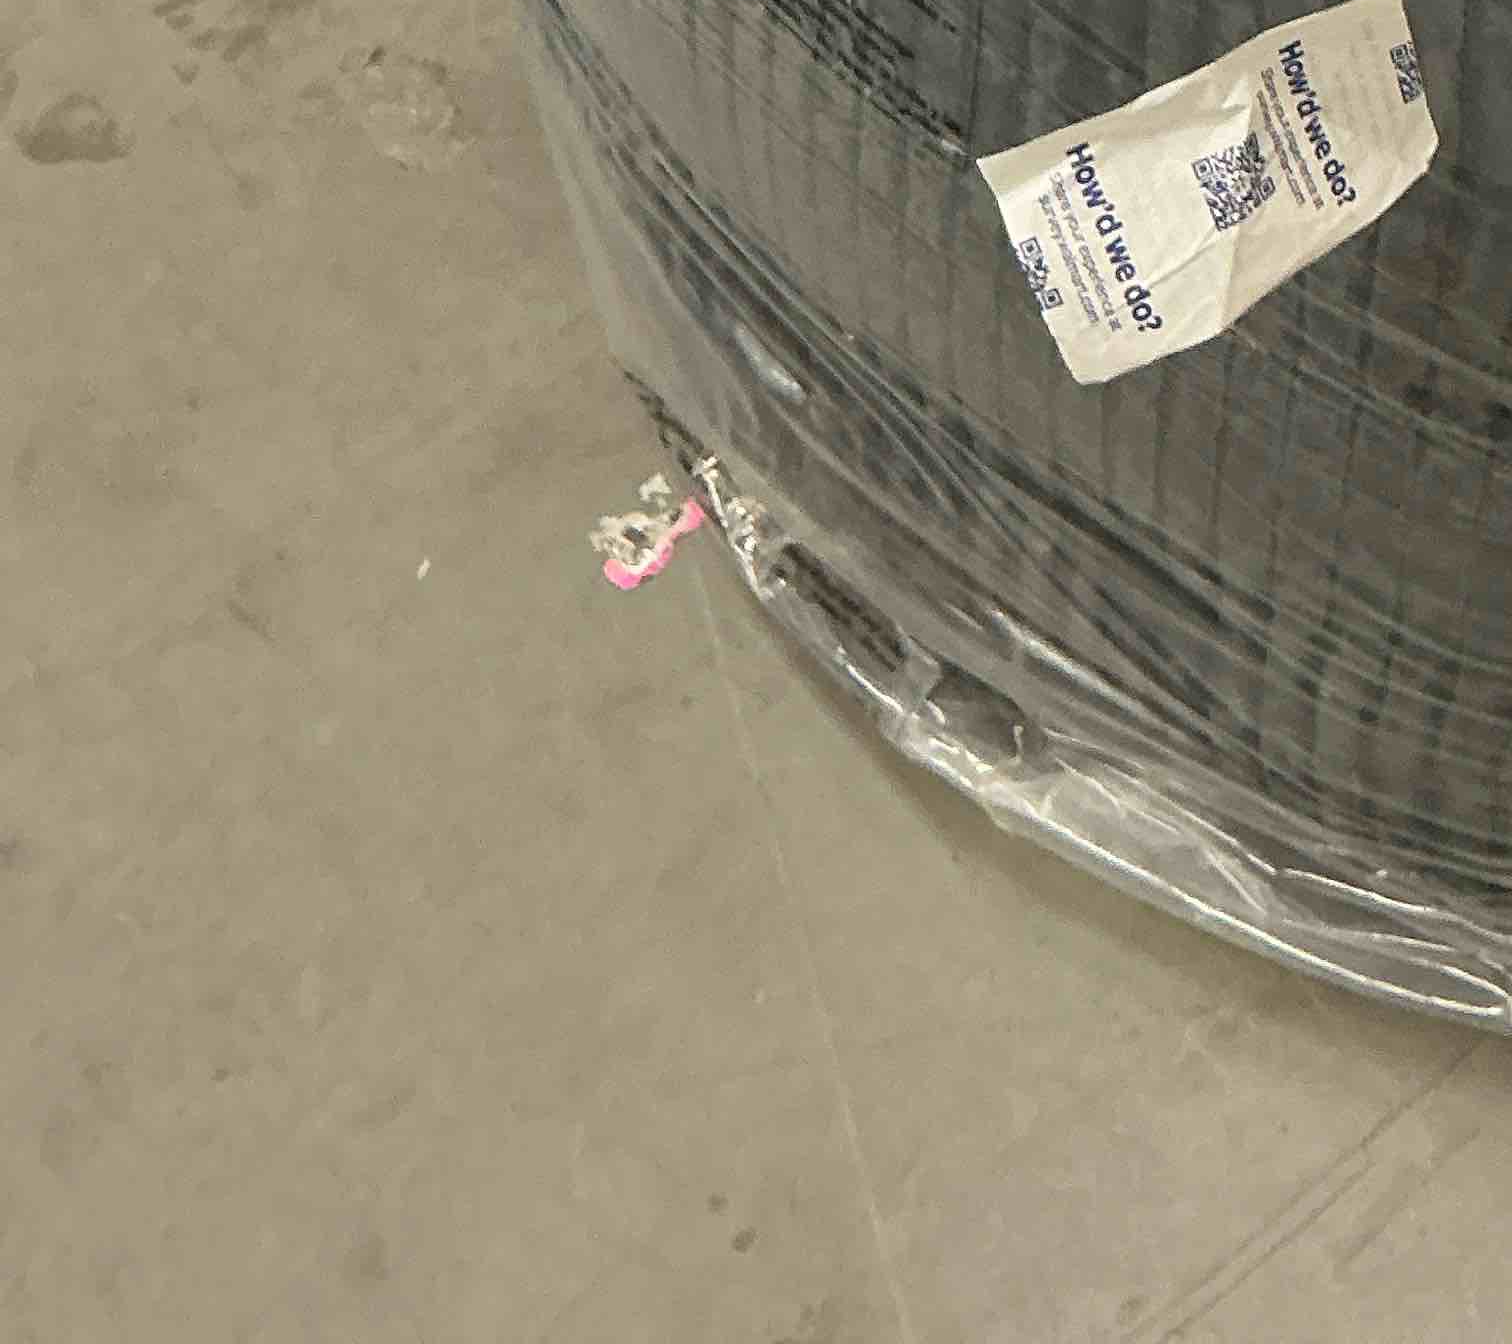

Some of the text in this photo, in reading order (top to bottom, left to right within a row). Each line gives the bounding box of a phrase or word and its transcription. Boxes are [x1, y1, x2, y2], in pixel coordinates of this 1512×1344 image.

[1279, 41, 1357, 208] How'd we do?
[1066, 142, 1163, 333] How'd we do?
